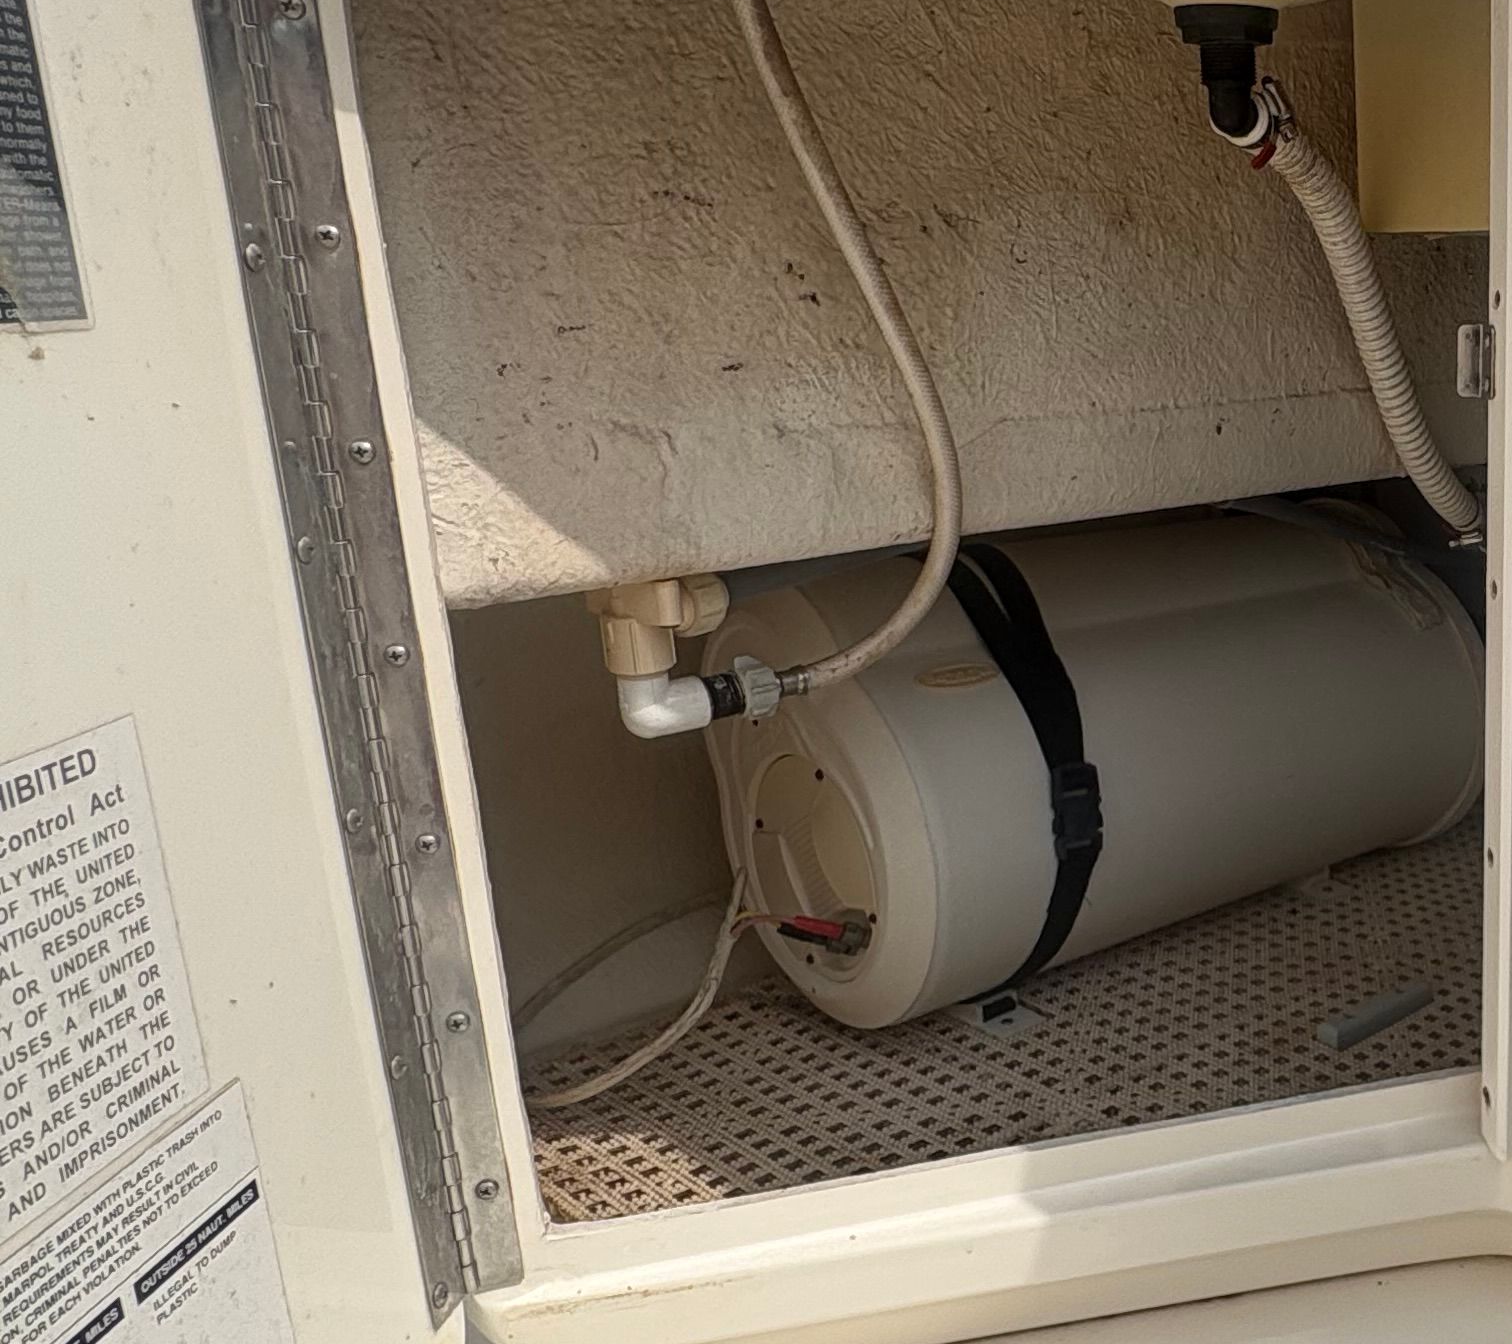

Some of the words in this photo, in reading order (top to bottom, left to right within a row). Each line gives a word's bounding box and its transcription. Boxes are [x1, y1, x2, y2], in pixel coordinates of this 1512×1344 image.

[90, 784, 125, 816] Act
[0, 868, 22, 895] LY
[27, 837, 90, 879] WASTE
[92, 818, 130, 849] INTO
[30, 877, 66, 907] THE
[75, 843, 135, 884] UNITED
[92, 869, 141, 905] ZONE,
[12, 979, 41, 1005] OR
[50, 939, 111, 984] UNDER
[119, 915, 151, 944] THE
[41, 892, 145, 961] RESOURCES
[0, 1030, 52, 1076] USES
[65, 1016, 78, 1035] A
[89, 984, 127, 1019] FILM
[137, 964, 161, 988] OR
[24, 1002, 48, 1029] OF
[56, 977, 93, 1008] THE
[99, 940, 155, 984] UNITED
[4, 1073, 29, 1101] OF
[36, 1046, 72, 1080] THE
[78, 1005, 137, 1053] WATER
[142, 987, 166, 1012] OR
[40, 1101, 77, 1140] ARE
[79, 1048, 151, 1110] SUBJECT
[153, 1035, 175, 1058] TO
[47, 1038, 128, 1103] BENEATH
[139, 1010, 171, 1041] THE
[8, 1181, 47, 1222] AND
[58, 1082, 186, 1183] IMPRISONMENT.
[22, 1120, 93, 1181] AND/OR
[105, 1059, 181, 1120] CRIMINAL
[56, 1212, 91, 1246] MIXED
[92, 1188, 121, 1216] WITH
[121, 1153, 165, 1195] PLASTIC
[165, 1128, 199, 1158] TRASH
[200, 1109, 222, 1134] INTO
[2, 1246, 95, 1328] REQUIREMENTS
[93, 1224, 120, 1253] MAY
[121, 1195, 161, 1230] RESULT
[163, 1180, 174, 1196] IN
[174, 1161, 199, 1187] CIVIL
[2, 1262, 55, 1308] MARPOL
[57, 1226, 99, 1264] TREATY
[102, 1205, 125, 1230] AND
[24, 1276, 81, 1328] CRIMINAL
[82, 1224, 141, 1278] PENALTIES
[142, 1204, 164, 1231] NOT
[166, 1195, 180, 1212] TO
[180, 1160, 219, 1198] EXCEED
[48, 1293, 83, 1325] EACH
[83, 1242, 143, 1296] VIOLATION.
[140, 1250, 184, 1294] OUTSIDE
[198, 1213, 227, 1244] NAUT.
[226, 1188, 255, 1220] MILES
[152, 1269, 195, 1313] ILLEGAL
[195, 1254, 210, 1273] TO
[210, 1230, 237, 1258] DUMP
[85, 1307, 119, 1344] MILES
[155, 1282, 199, 1326] PLASTIC
